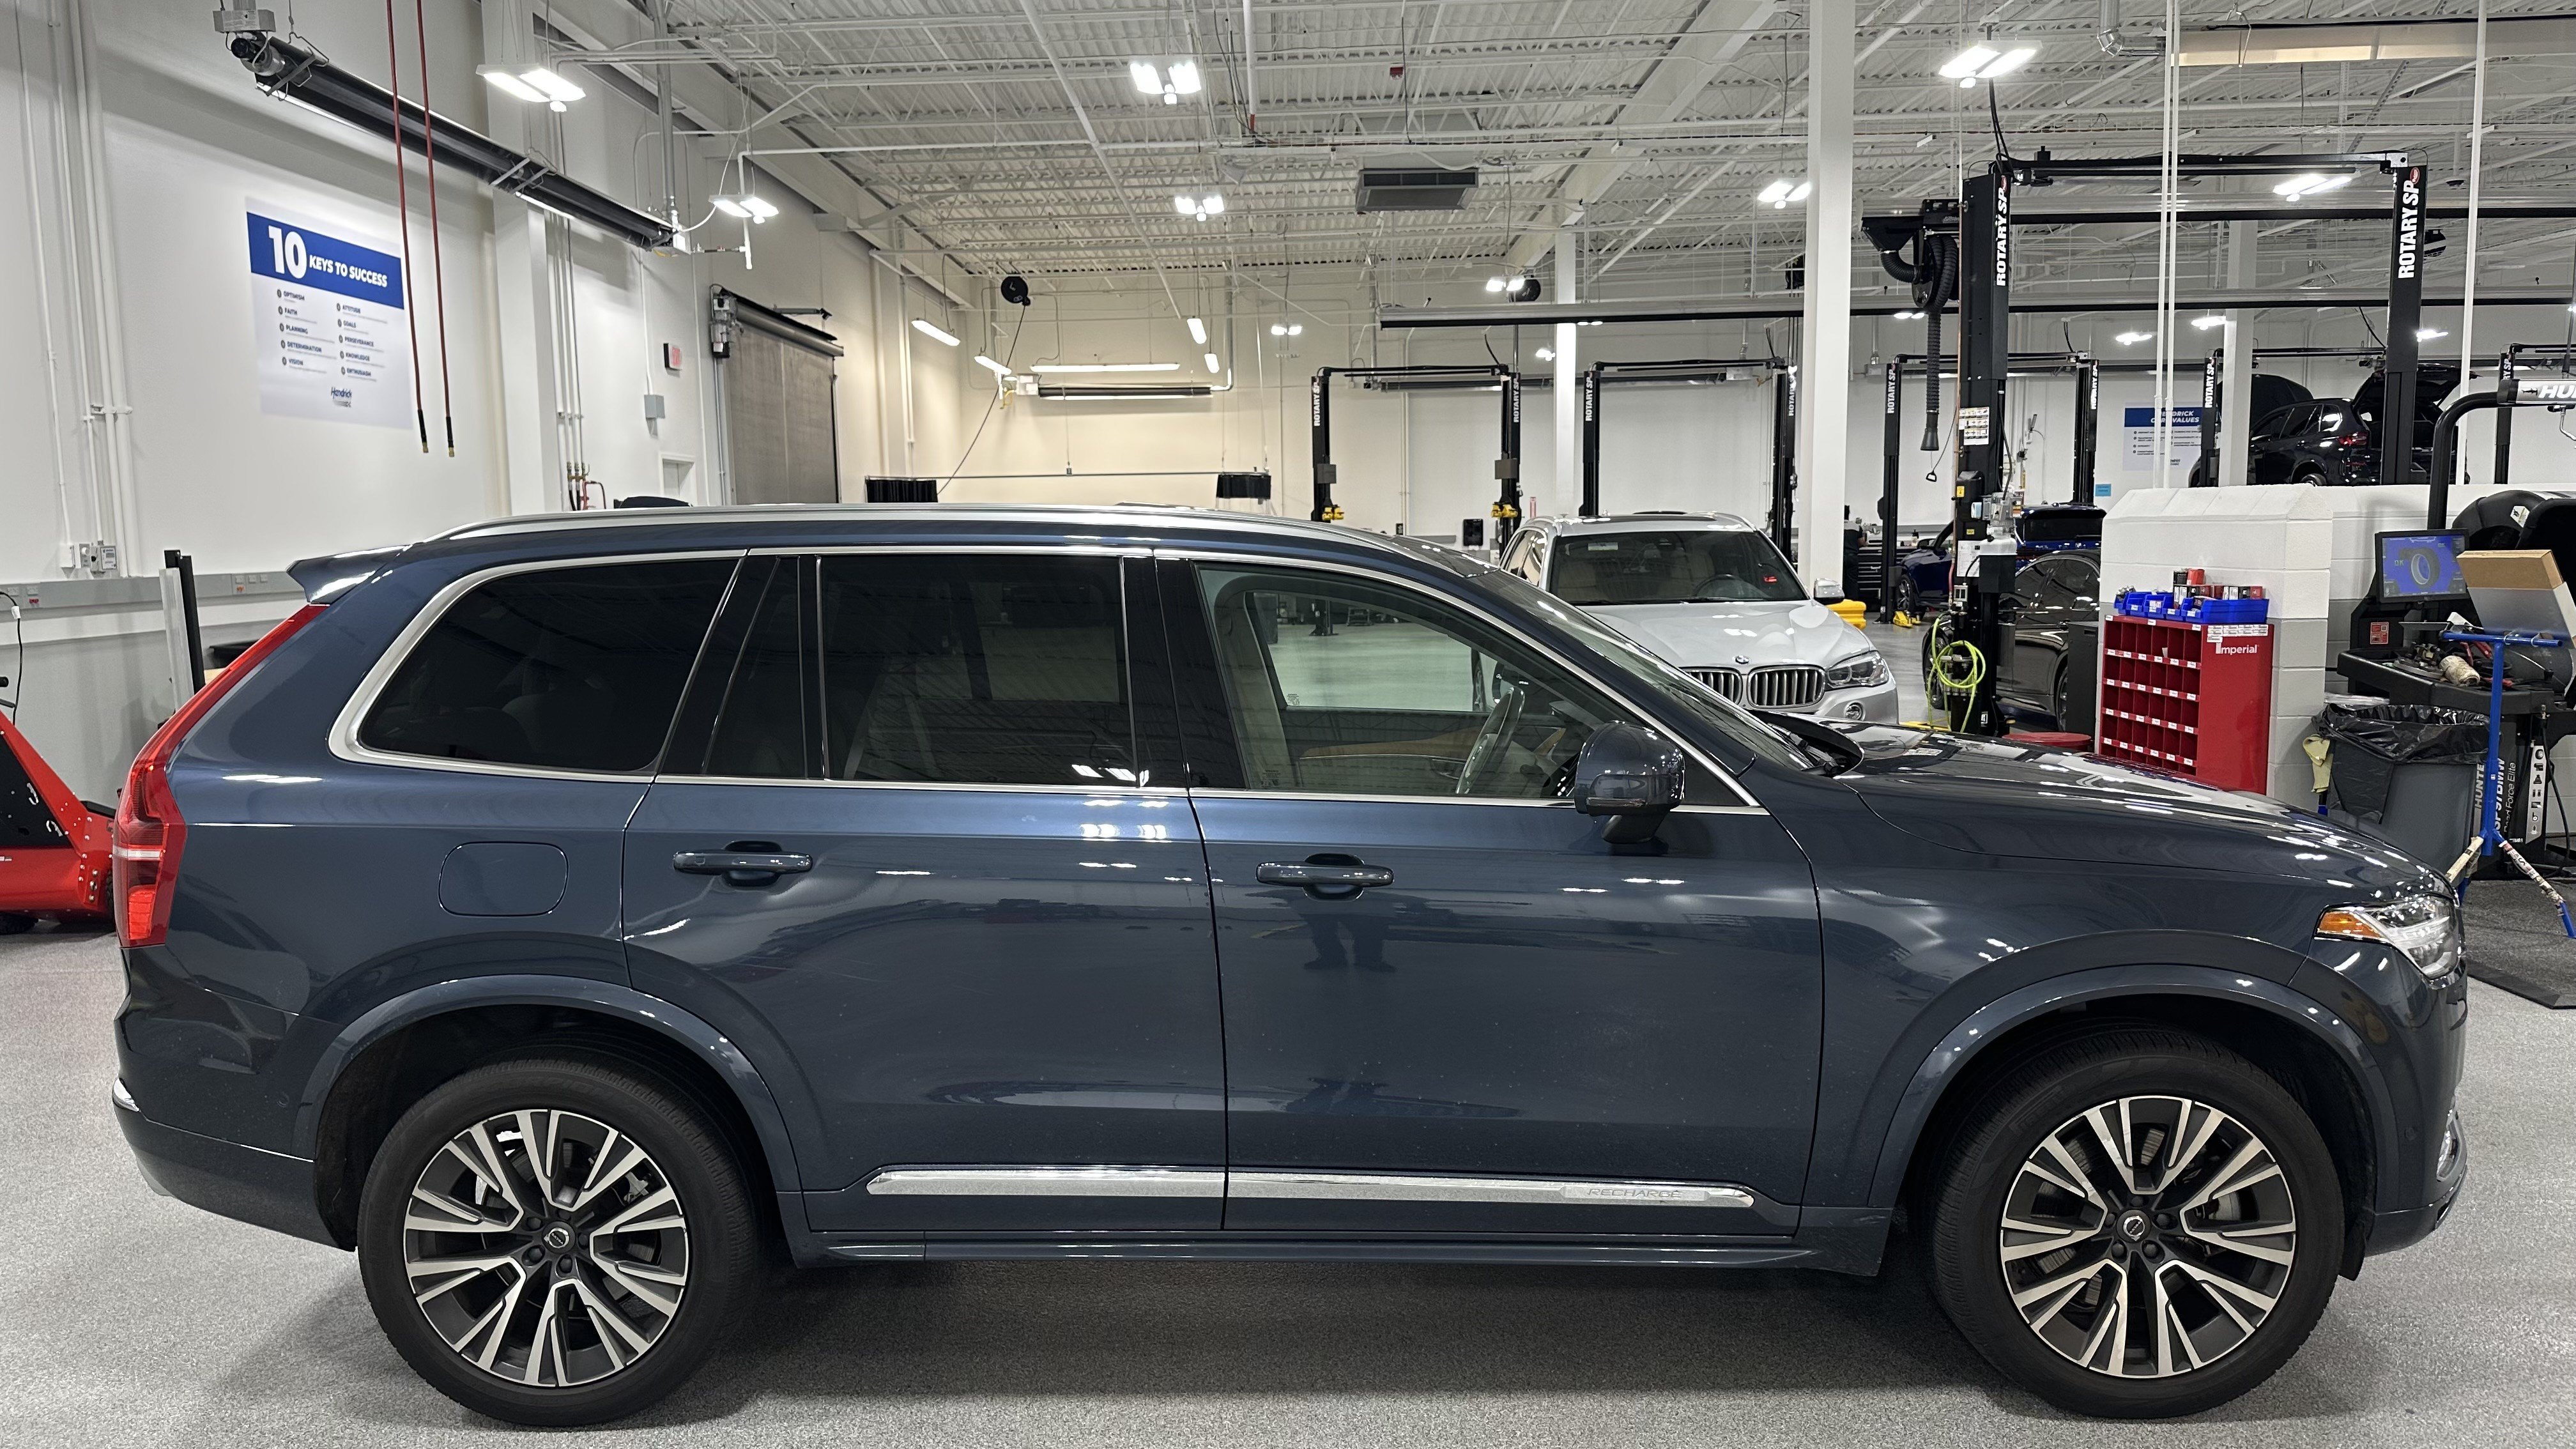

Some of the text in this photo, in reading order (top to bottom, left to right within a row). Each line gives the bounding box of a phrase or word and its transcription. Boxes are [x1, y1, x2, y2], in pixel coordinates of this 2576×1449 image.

[1997, 187, 2007, 286] ROTARY SP
[2398, 180, 2419, 279] ROTARY SP
[268, 225, 387, 288] 10 KEYS TO SUCCESS
[283, 291, 305, 300] OPTIMISM
[286, 325, 308, 334] PLANNING
[287, 341, 322, 353] DETERMINATION
[344, 336, 374, 347] PERSEVERANCE
[346, 353, 370, 361] KNOWLEDGE
[346, 368, 371, 376] ENTHUSIASM
[1586, 376, 1593, 388] SP
[2205, 363, 2214, 408] ROTARY SP
[331, 387, 352, 399] Hendrick
[1887, 369, 1896, 413] ROTARY SP
[2538, 385, 2576, 399] HU
[2216, 642, 2258, 656] Imperial
[2507, 763, 2516, 782] Elite
[2474, 763, 2485, 808] HUNTE
[2506, 784, 2515, 808] Force
[1587, 1188, 1683, 1199] RECHARGE
